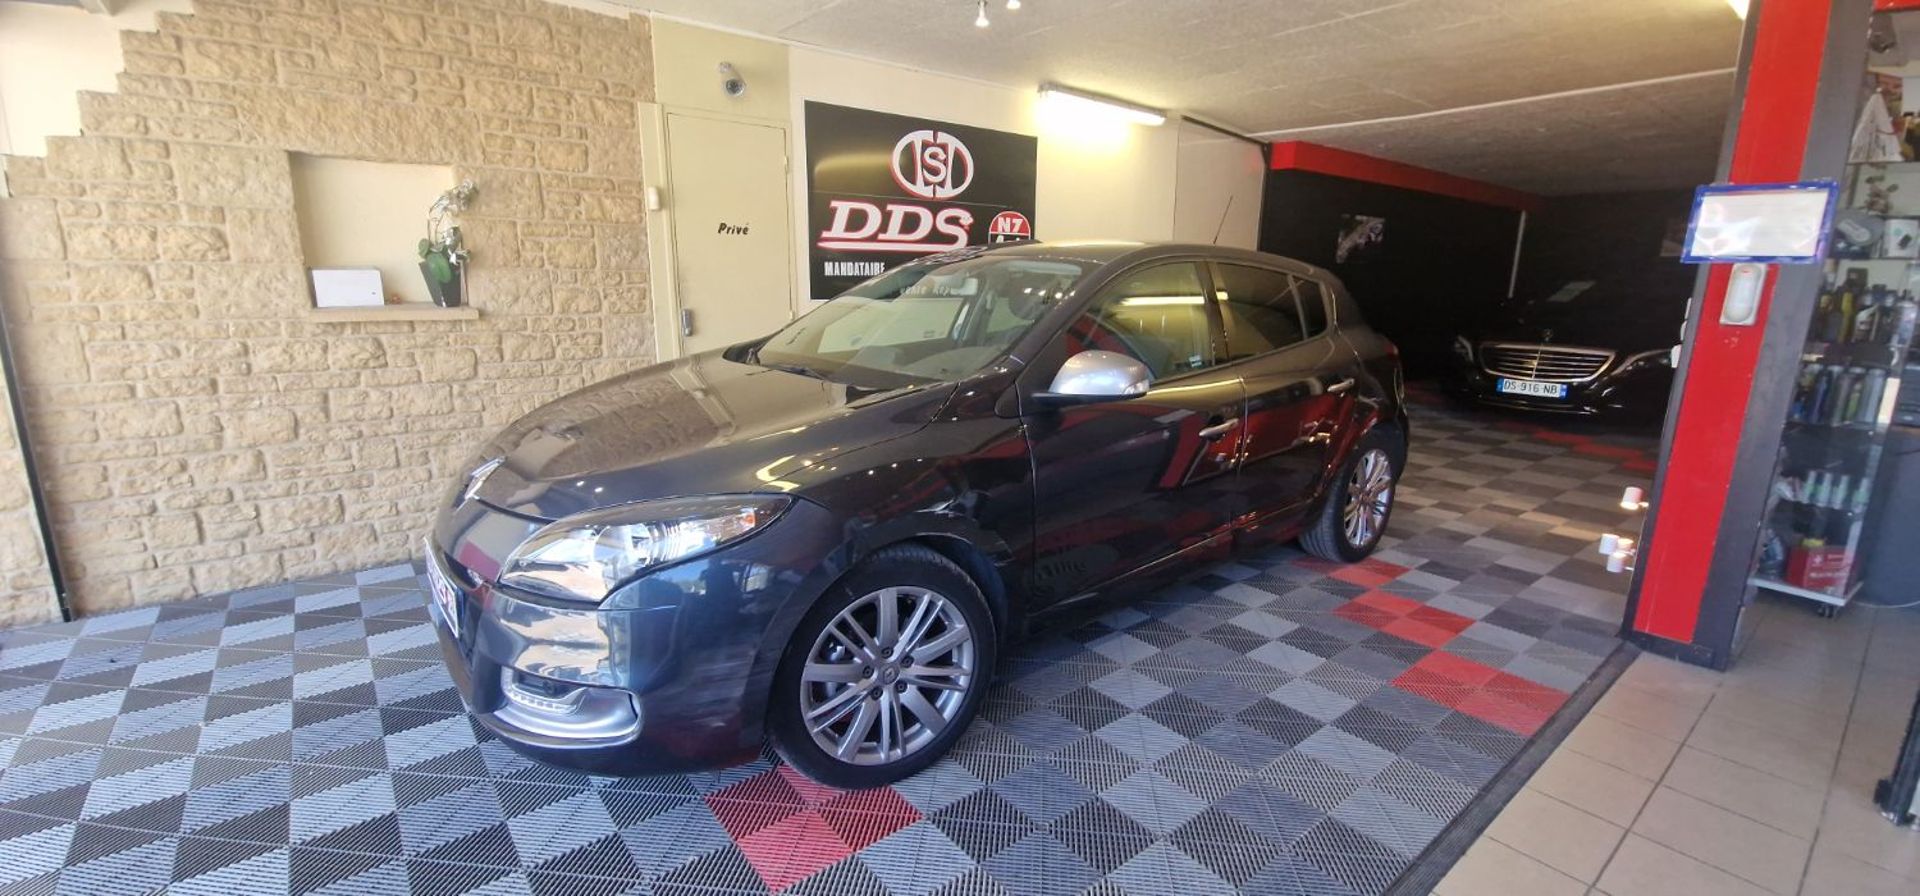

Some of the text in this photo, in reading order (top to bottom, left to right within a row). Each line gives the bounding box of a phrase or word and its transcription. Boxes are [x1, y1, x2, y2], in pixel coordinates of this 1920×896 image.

[717, 222, 750, 235] Privé
[818, 200, 974, 252] DDS
[998, 217, 1024, 234] N7
